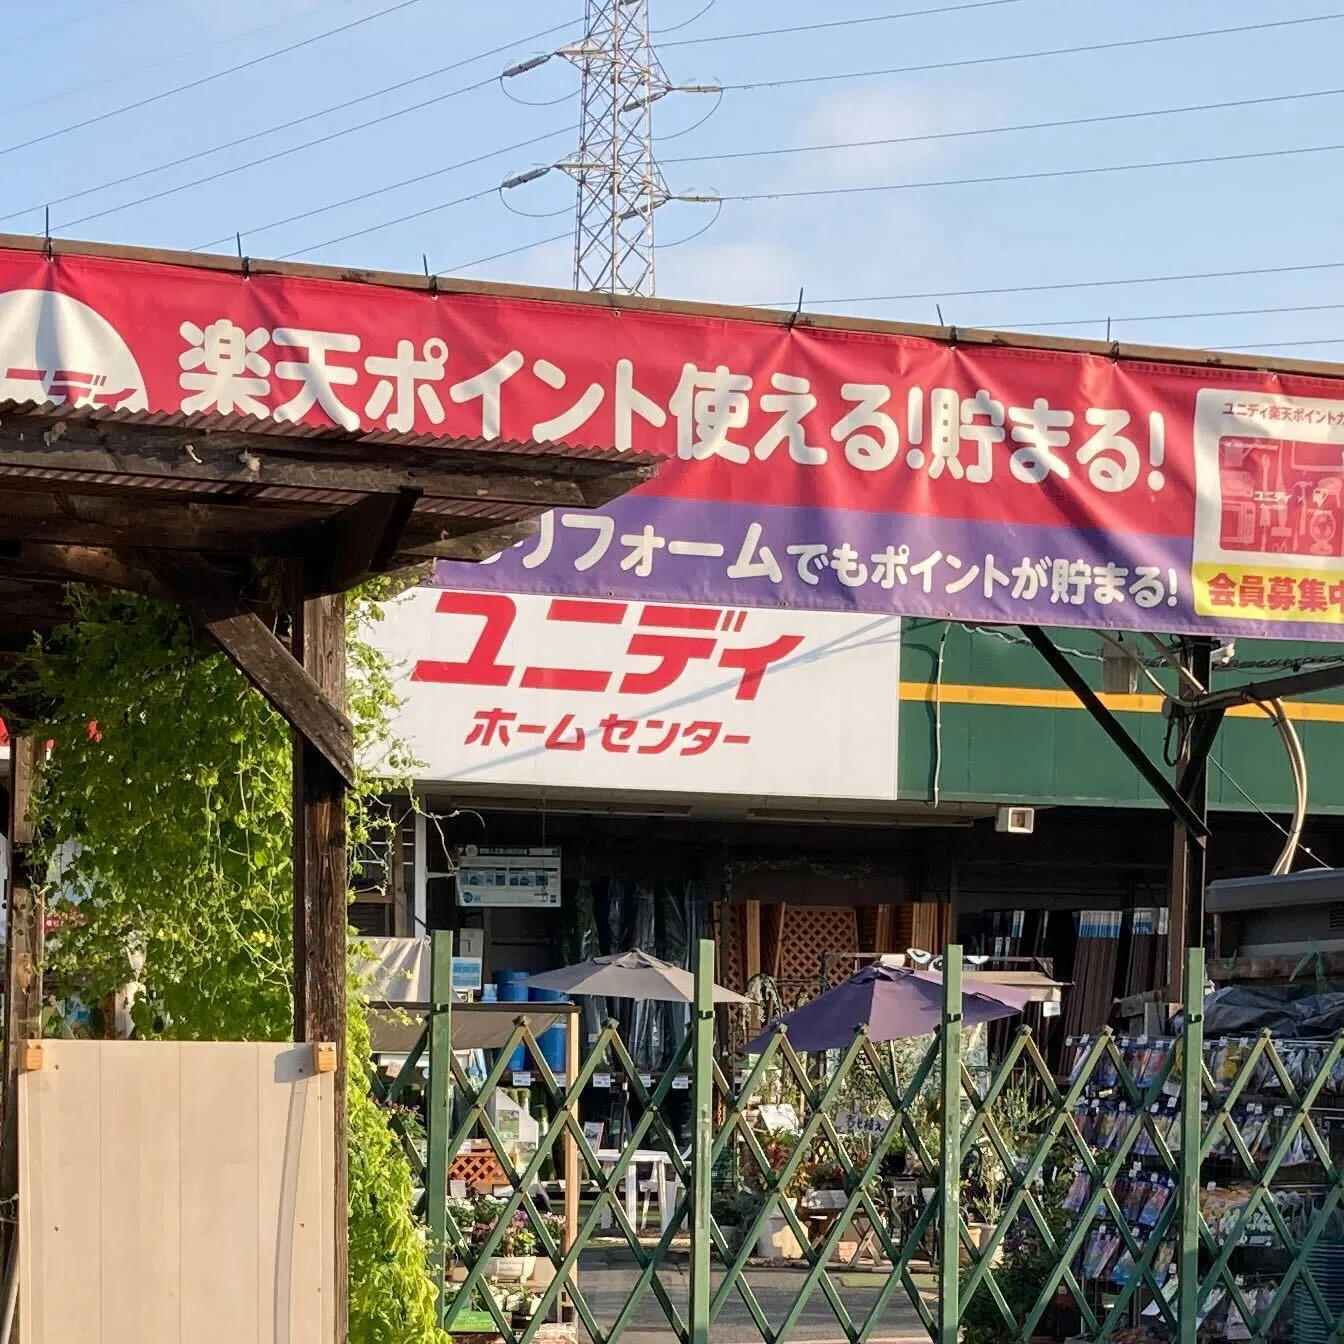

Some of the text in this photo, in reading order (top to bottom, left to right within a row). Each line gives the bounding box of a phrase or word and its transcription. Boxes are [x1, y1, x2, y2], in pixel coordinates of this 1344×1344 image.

[480, 510, 1178, 609] リフォームでもポイントが貯まる!
[411, 591, 805, 701] ユニディ
[464, 707, 751, 757] ホームセンター
